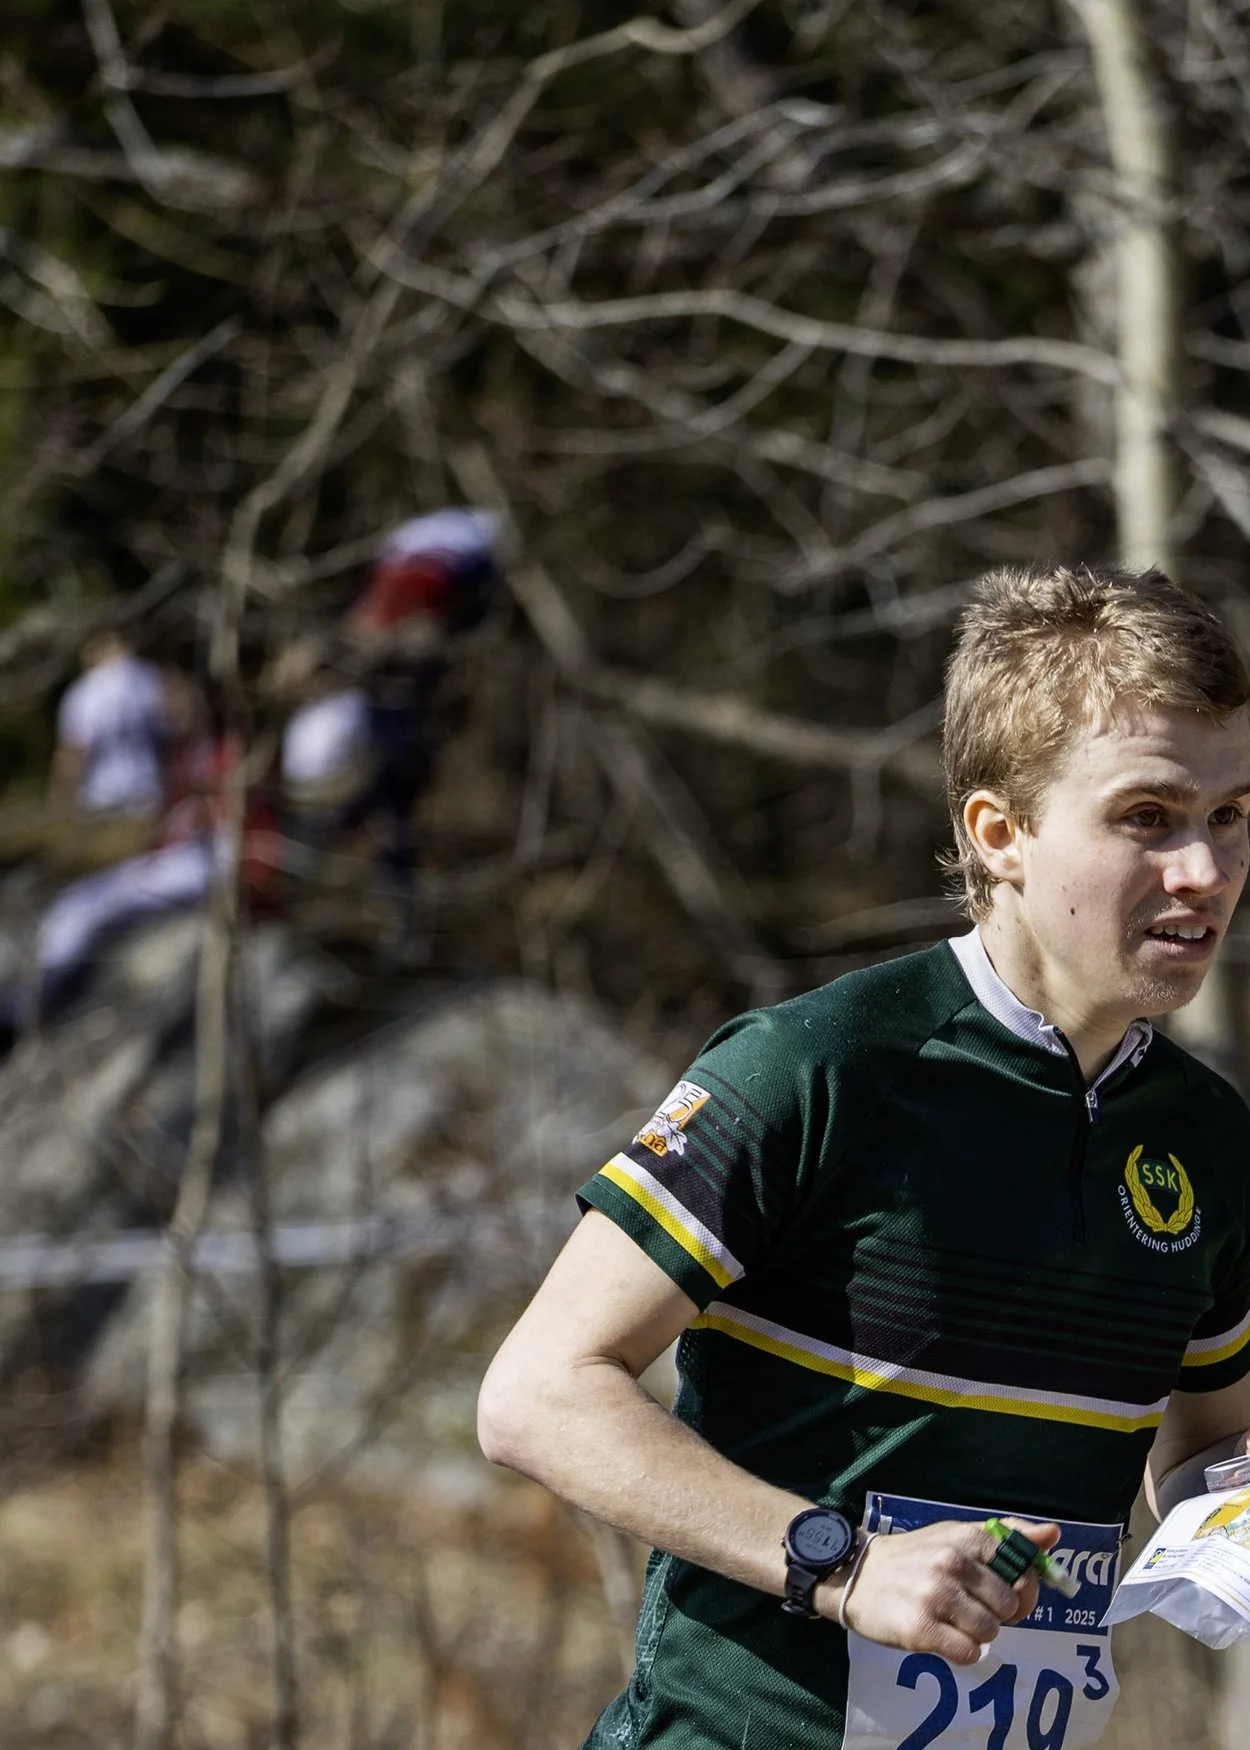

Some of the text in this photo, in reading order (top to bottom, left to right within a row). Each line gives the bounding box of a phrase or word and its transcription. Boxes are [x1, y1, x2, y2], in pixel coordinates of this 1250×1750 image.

[1142, 1164, 1178, 1192] SSK
[1117, 1185, 1168, 1253] ORIENTERING
[1065, 1608, 1096, 1626] 2025
[1076, 1644, 1110, 1700] 3
